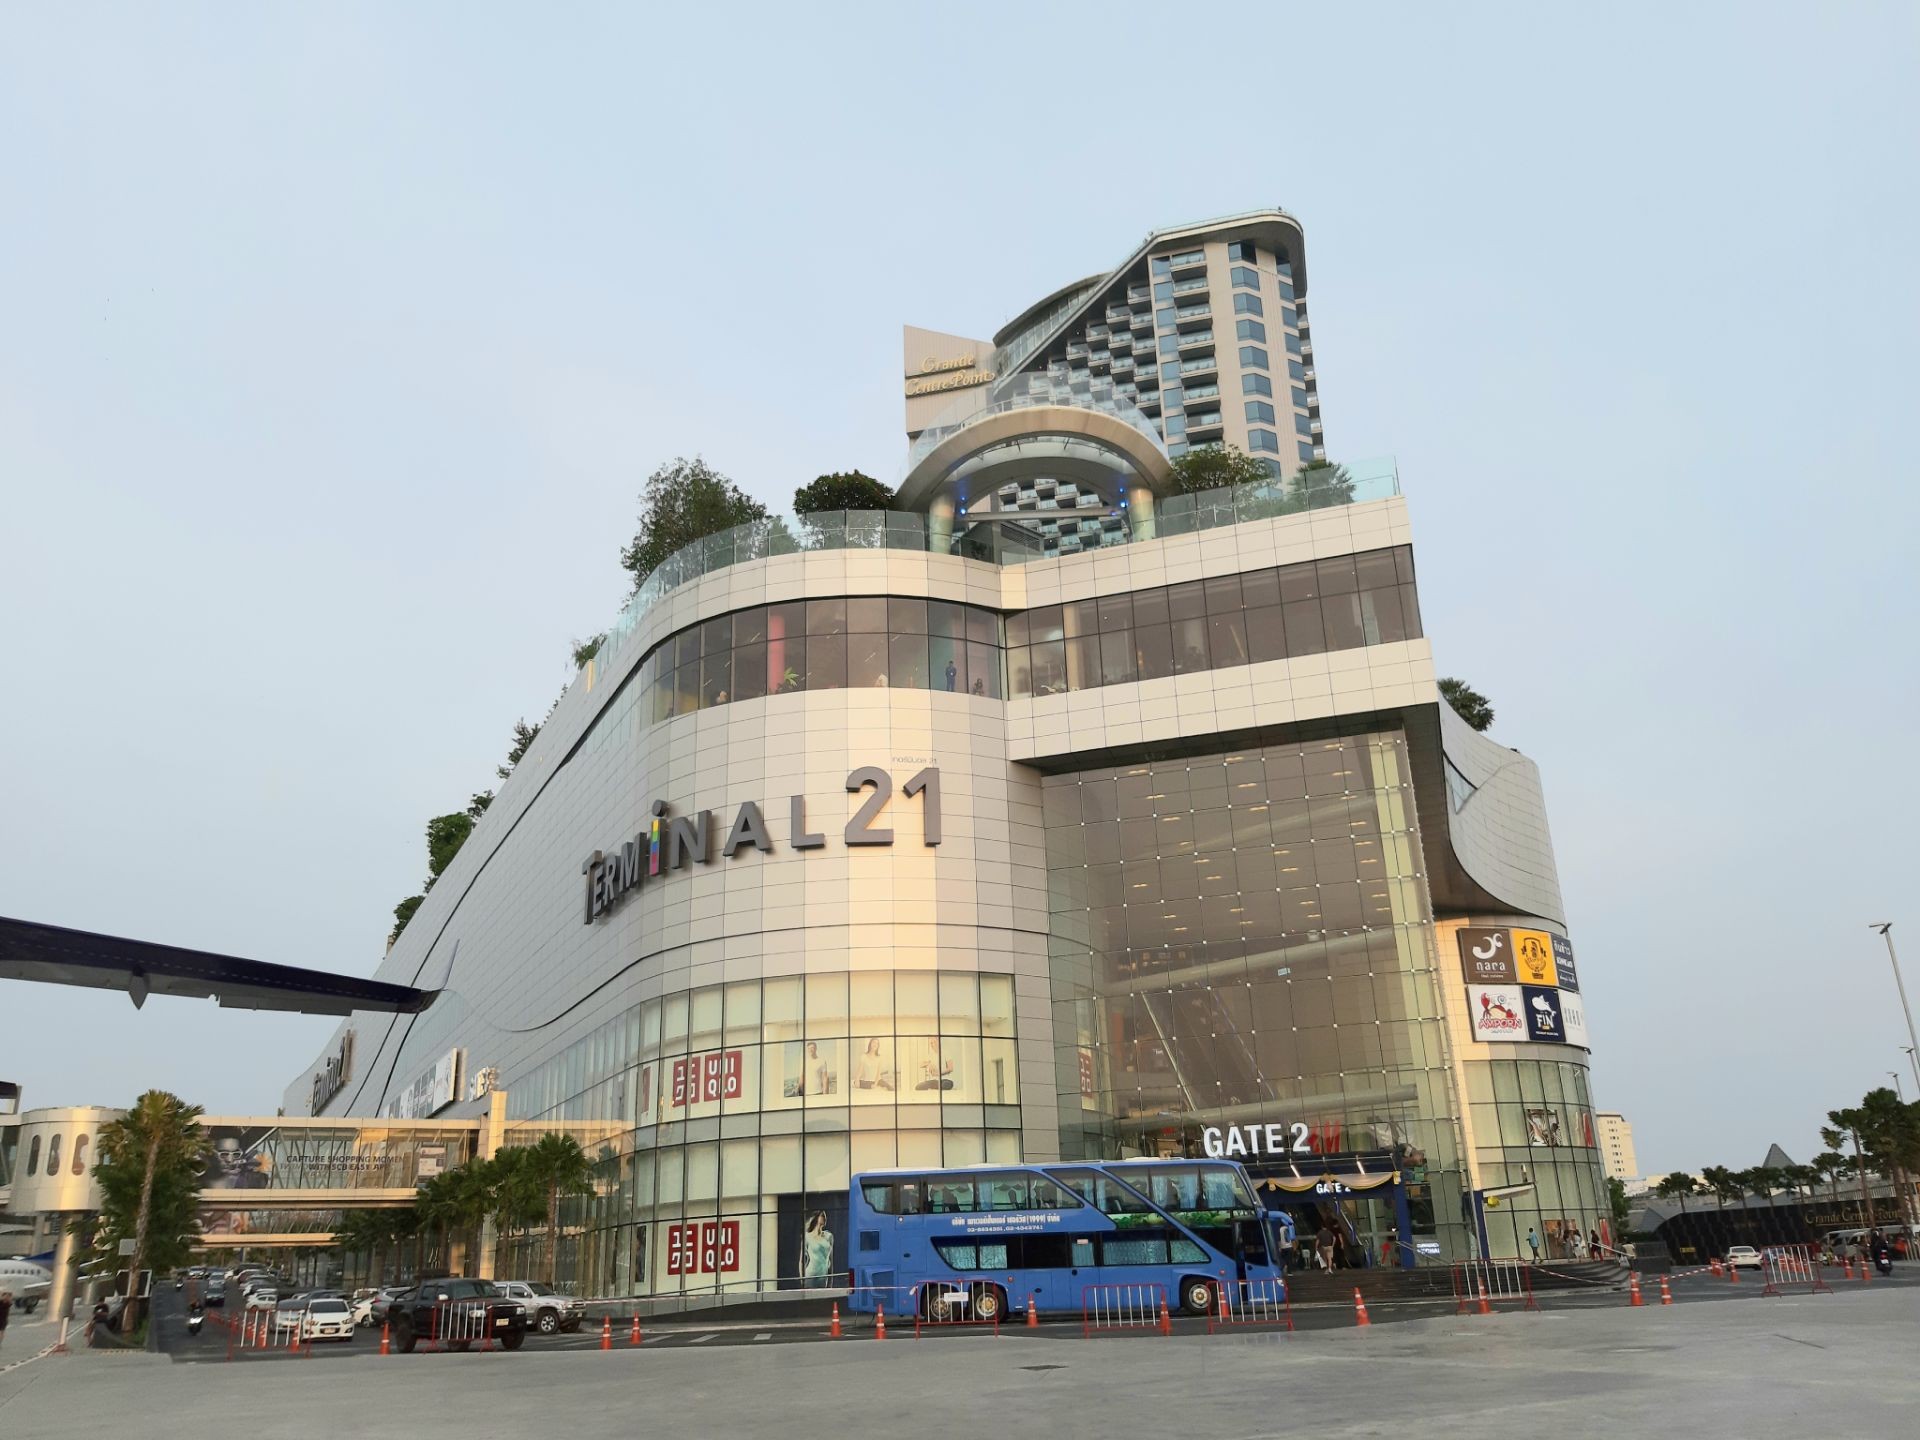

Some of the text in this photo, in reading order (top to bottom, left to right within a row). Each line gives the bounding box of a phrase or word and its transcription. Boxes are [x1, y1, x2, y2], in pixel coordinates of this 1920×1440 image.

[844, 766, 942, 848] 21
[1476, 962, 1506, 970] nara
[1536, 1012, 1554, 1028] FIN
[1203, 1123, 1284, 1157] GATE
[1290, 1122, 1311, 1152] 2
[286, 1155, 325, 1163] CAPTURE
[328, 1155, 371, 1163] SHOPPING
